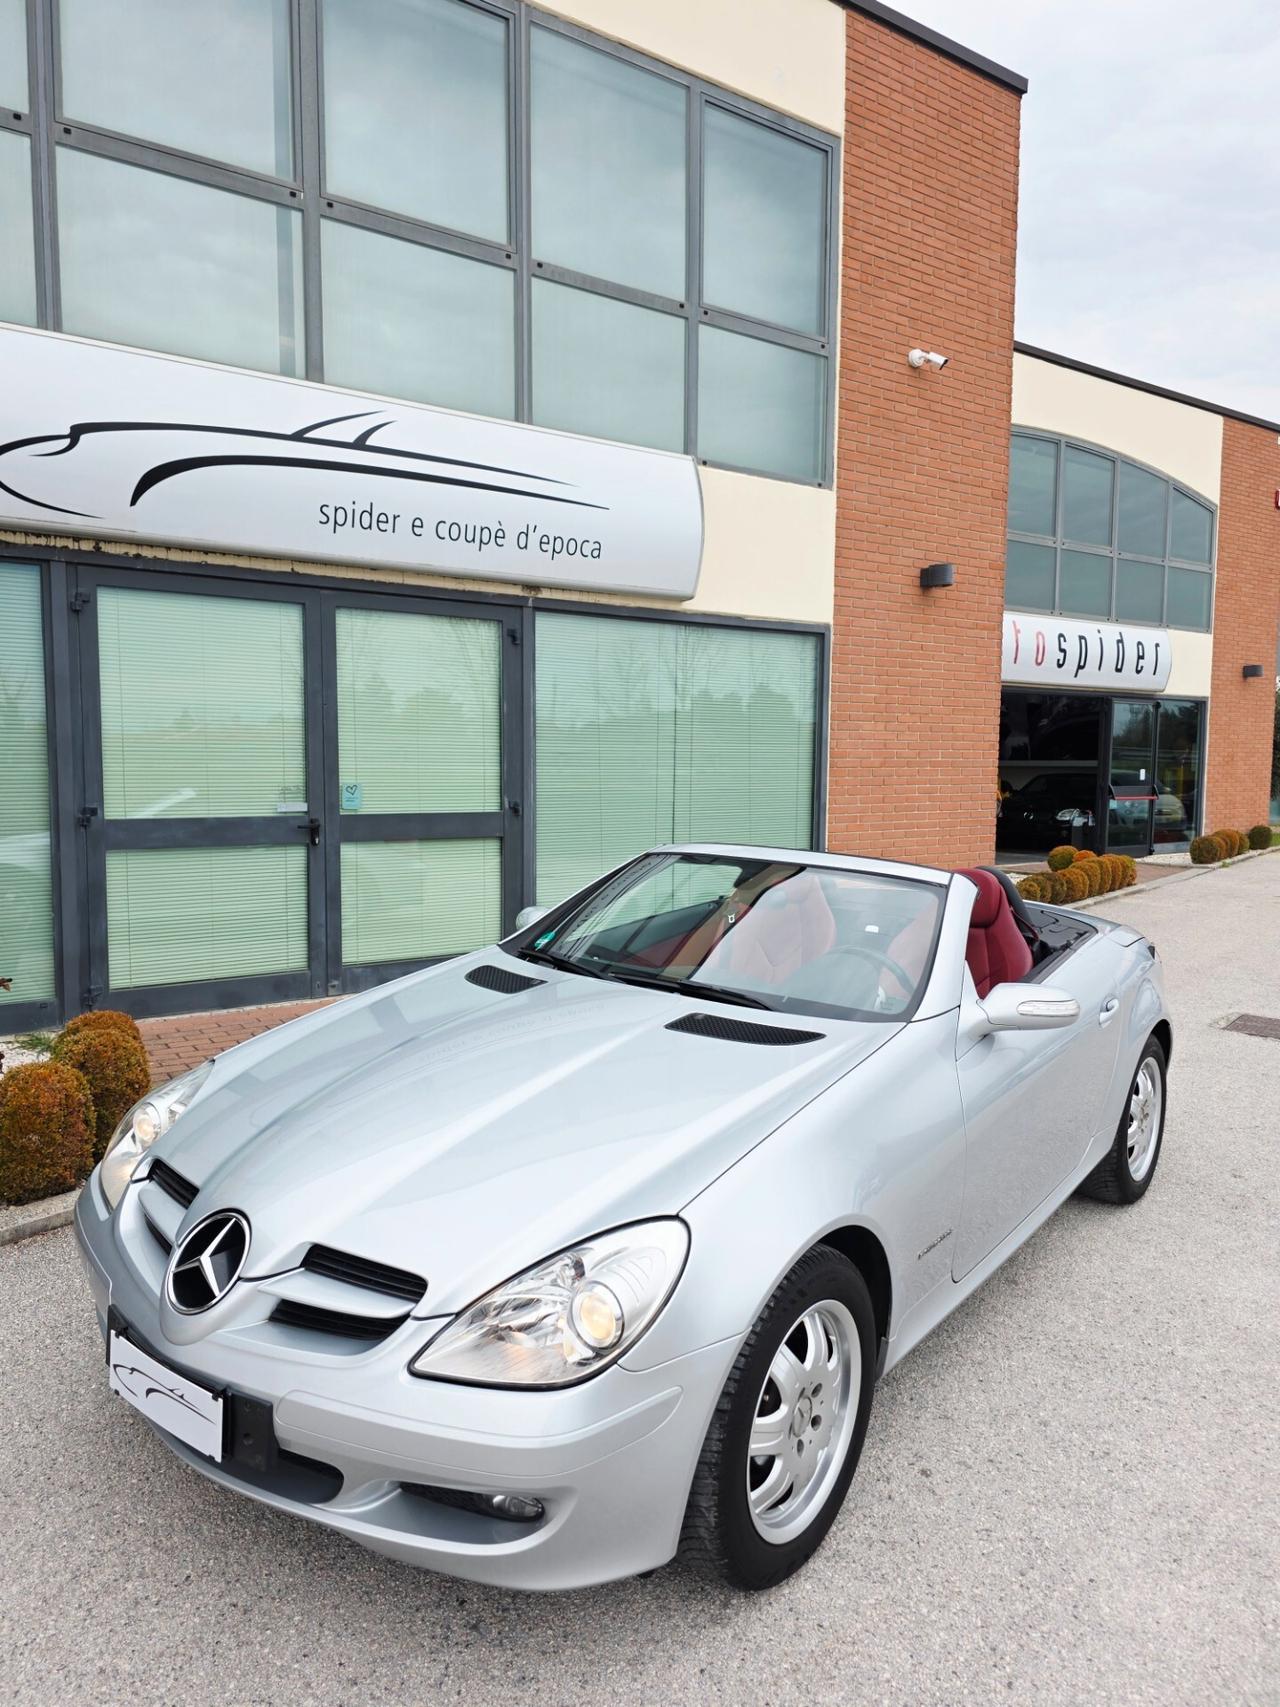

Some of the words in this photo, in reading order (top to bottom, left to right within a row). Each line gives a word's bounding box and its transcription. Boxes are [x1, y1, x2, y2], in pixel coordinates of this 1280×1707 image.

[319, 500, 401, 534] spider
[411, 516, 424, 537] e
[434, 520, 506, 552] coupè
[516, 523, 602, 561] d'epoca
